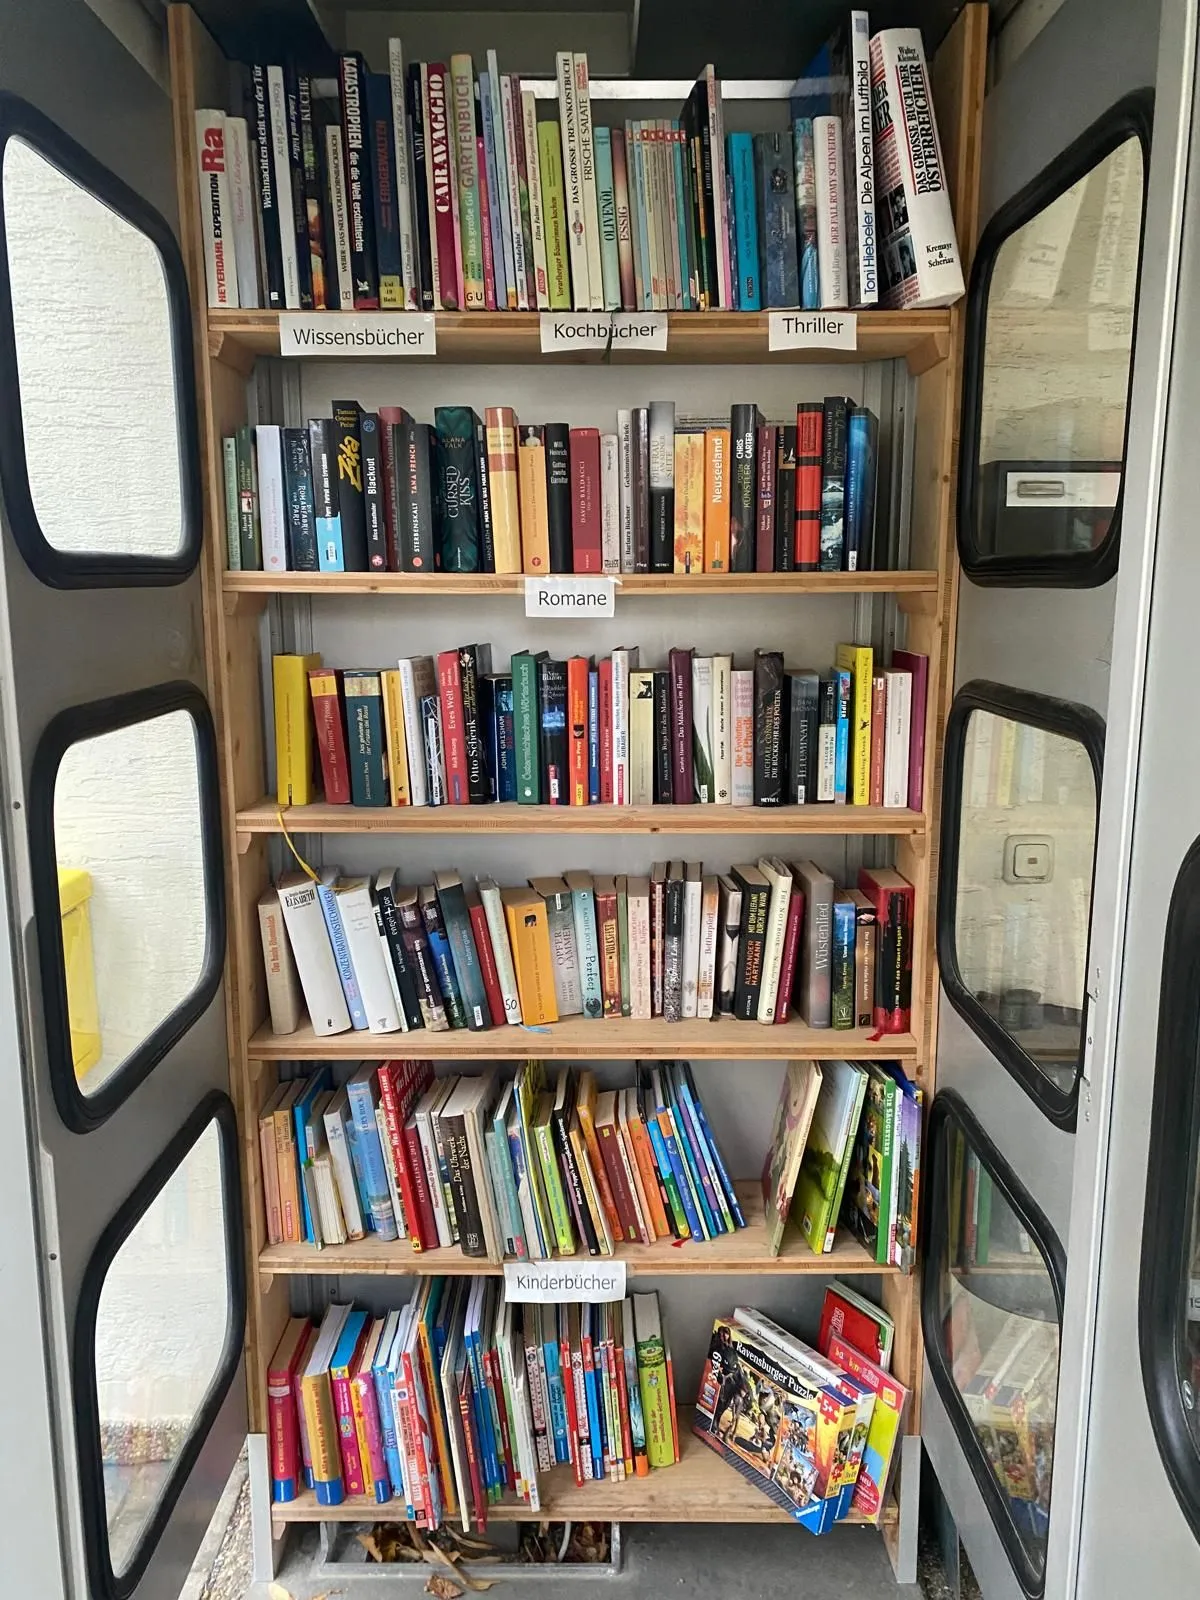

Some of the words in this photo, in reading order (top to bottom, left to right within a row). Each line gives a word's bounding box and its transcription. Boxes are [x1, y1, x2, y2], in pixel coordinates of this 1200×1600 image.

[252, 65, 263, 83] Tür
[858, 60, 869, 112] Luftbild
[899, 64, 911, 88] DER
[254, 86, 264, 102] der
[343, 57, 362, 149] KATASTROPHEN
[562, 58, 576, 143] TRENNKOSTBUCH
[903, 91, 917, 122] BUCH
[256, 103, 265, 119] vor
[579, 98, 589, 134] SALATE
[257, 120, 267, 146] steht
[455, 75, 475, 189] GARTENBUCH
[859, 116, 869, 134] im
[909, 63, 941, 193] ÖSTERREICHER
[201, 127, 225, 173] Ra
[430, 74, 450, 213] CARAVAGGIO
[827, 123, 837, 176] SCHNEIDER
[908, 124, 926, 170] GROSSE
[350, 151, 359, 166] die
[568, 145, 578, 183] GROSSE
[581, 136, 592, 180] FRISCHE
[860, 136, 873, 179] Alpen
[259, 147, 273, 209] Weihnachten
[350, 167, 360, 181] die
[914, 172, 930, 194] DAS
[351, 181, 361, 200] Welt
[464, 191, 474, 205] GU
[570, 184, 580, 204] DAS
[828, 179, 837, 203] ROMY
[861, 182, 873, 204] Die
[210, 173, 224, 238] EXPEDITION
[550, 196, 559, 219] kochen
[601, 187, 615, 241] OLIVENÖL
[829, 204, 838, 226] FALL
[337, 213, 345, 231] NEUE
[352, 201, 364, 252] erschütterten
[464, 207, 476, 233] große
[618, 205, 630, 241] ESSIG
[467, 238, 476, 256] Das
[830, 228, 839, 244] DER
[861, 210, 874, 268] Hiebeler
[926, 241, 953, 253] Kremayr
[938, 251, 944, 259] &
[213, 240, 227, 303] HEYERDAHL
[555, 257, 565, 297] Vorarlberger
[864, 268, 876, 295] Toni
[293, 327, 425, 346] Wissensbücher
[553, 321, 657, 339] Kochbücher
[782, 317, 844, 334] Thriller
[651, 439, 659, 464] FRAU
[736, 439, 744, 459] CHRIS
[745, 432, 753, 459] CARTER
[366, 457, 376, 495] Blackout
[623, 443, 631, 488] Geheimnisvolle
[712, 437, 723, 504] Neuseeland
[445, 465, 461, 519] CURSED
[459, 477, 474, 508] KISS
[412, 502, 420, 552] STERBENSKALT
[539, 590, 607, 606] Romane
[446, 690, 454, 710] Welt
[519, 663, 530, 713] Wörterbuch
[659, 689, 667, 713] Matador
[677, 691, 683, 699] im
[447, 711, 456, 729] Eves
[676, 699, 684, 725] Mädchen
[772, 717, 780, 731] DES
[465, 719, 479, 758] Schenk
[499, 715, 507, 749] GRISHAM
[797, 719, 809, 778] ILLUMINATI
[468, 759, 480, 783] Otto
[323, 888, 351, 981] KONZENTRATIONSTECHNIKEN
[413, 939, 422, 951] Weg
[605, 923, 616, 955] VOLKSFEST
[815, 902, 829, 970] Wüstenlied
[554, 930, 565, 966] OPFER
[416, 951, 429, 981] gemeinsame
[585, 955, 598, 991] Perfect
[745, 940, 754, 985] ALEXANDER
[751, 940, 762, 986] HARTMANN
[504, 999, 517, 1010] 50
[380, 1075, 389, 1092] essen
[383, 1093, 393, 1110] gerne
[886, 1092, 894, 1104] DIE
[386, 1111, 397, 1131] Kinder
[390, 1132, 400, 1146] Was
[408, 1139, 418, 1156] 2012
[448, 1136, 459, 1168] Uhrwerk
[458, 1135, 468, 1158] Nacht
[453, 1169, 462, 1183] Das
[461, 1159, 470, 1170] der
[413, 1157, 425, 1203] CHECKLISTE
[517, 1274, 617, 1290] Kinderbücher
[708, 1351, 722, 1384] 3x49
[736, 1342, 787, 1382] Ravensburger
[788, 1377, 814, 1400] Puzzle
[822, 1400, 833, 1414] 5+
[320, 1457, 328, 1474] Alles
[860, 1474, 872, 1487] NEU
